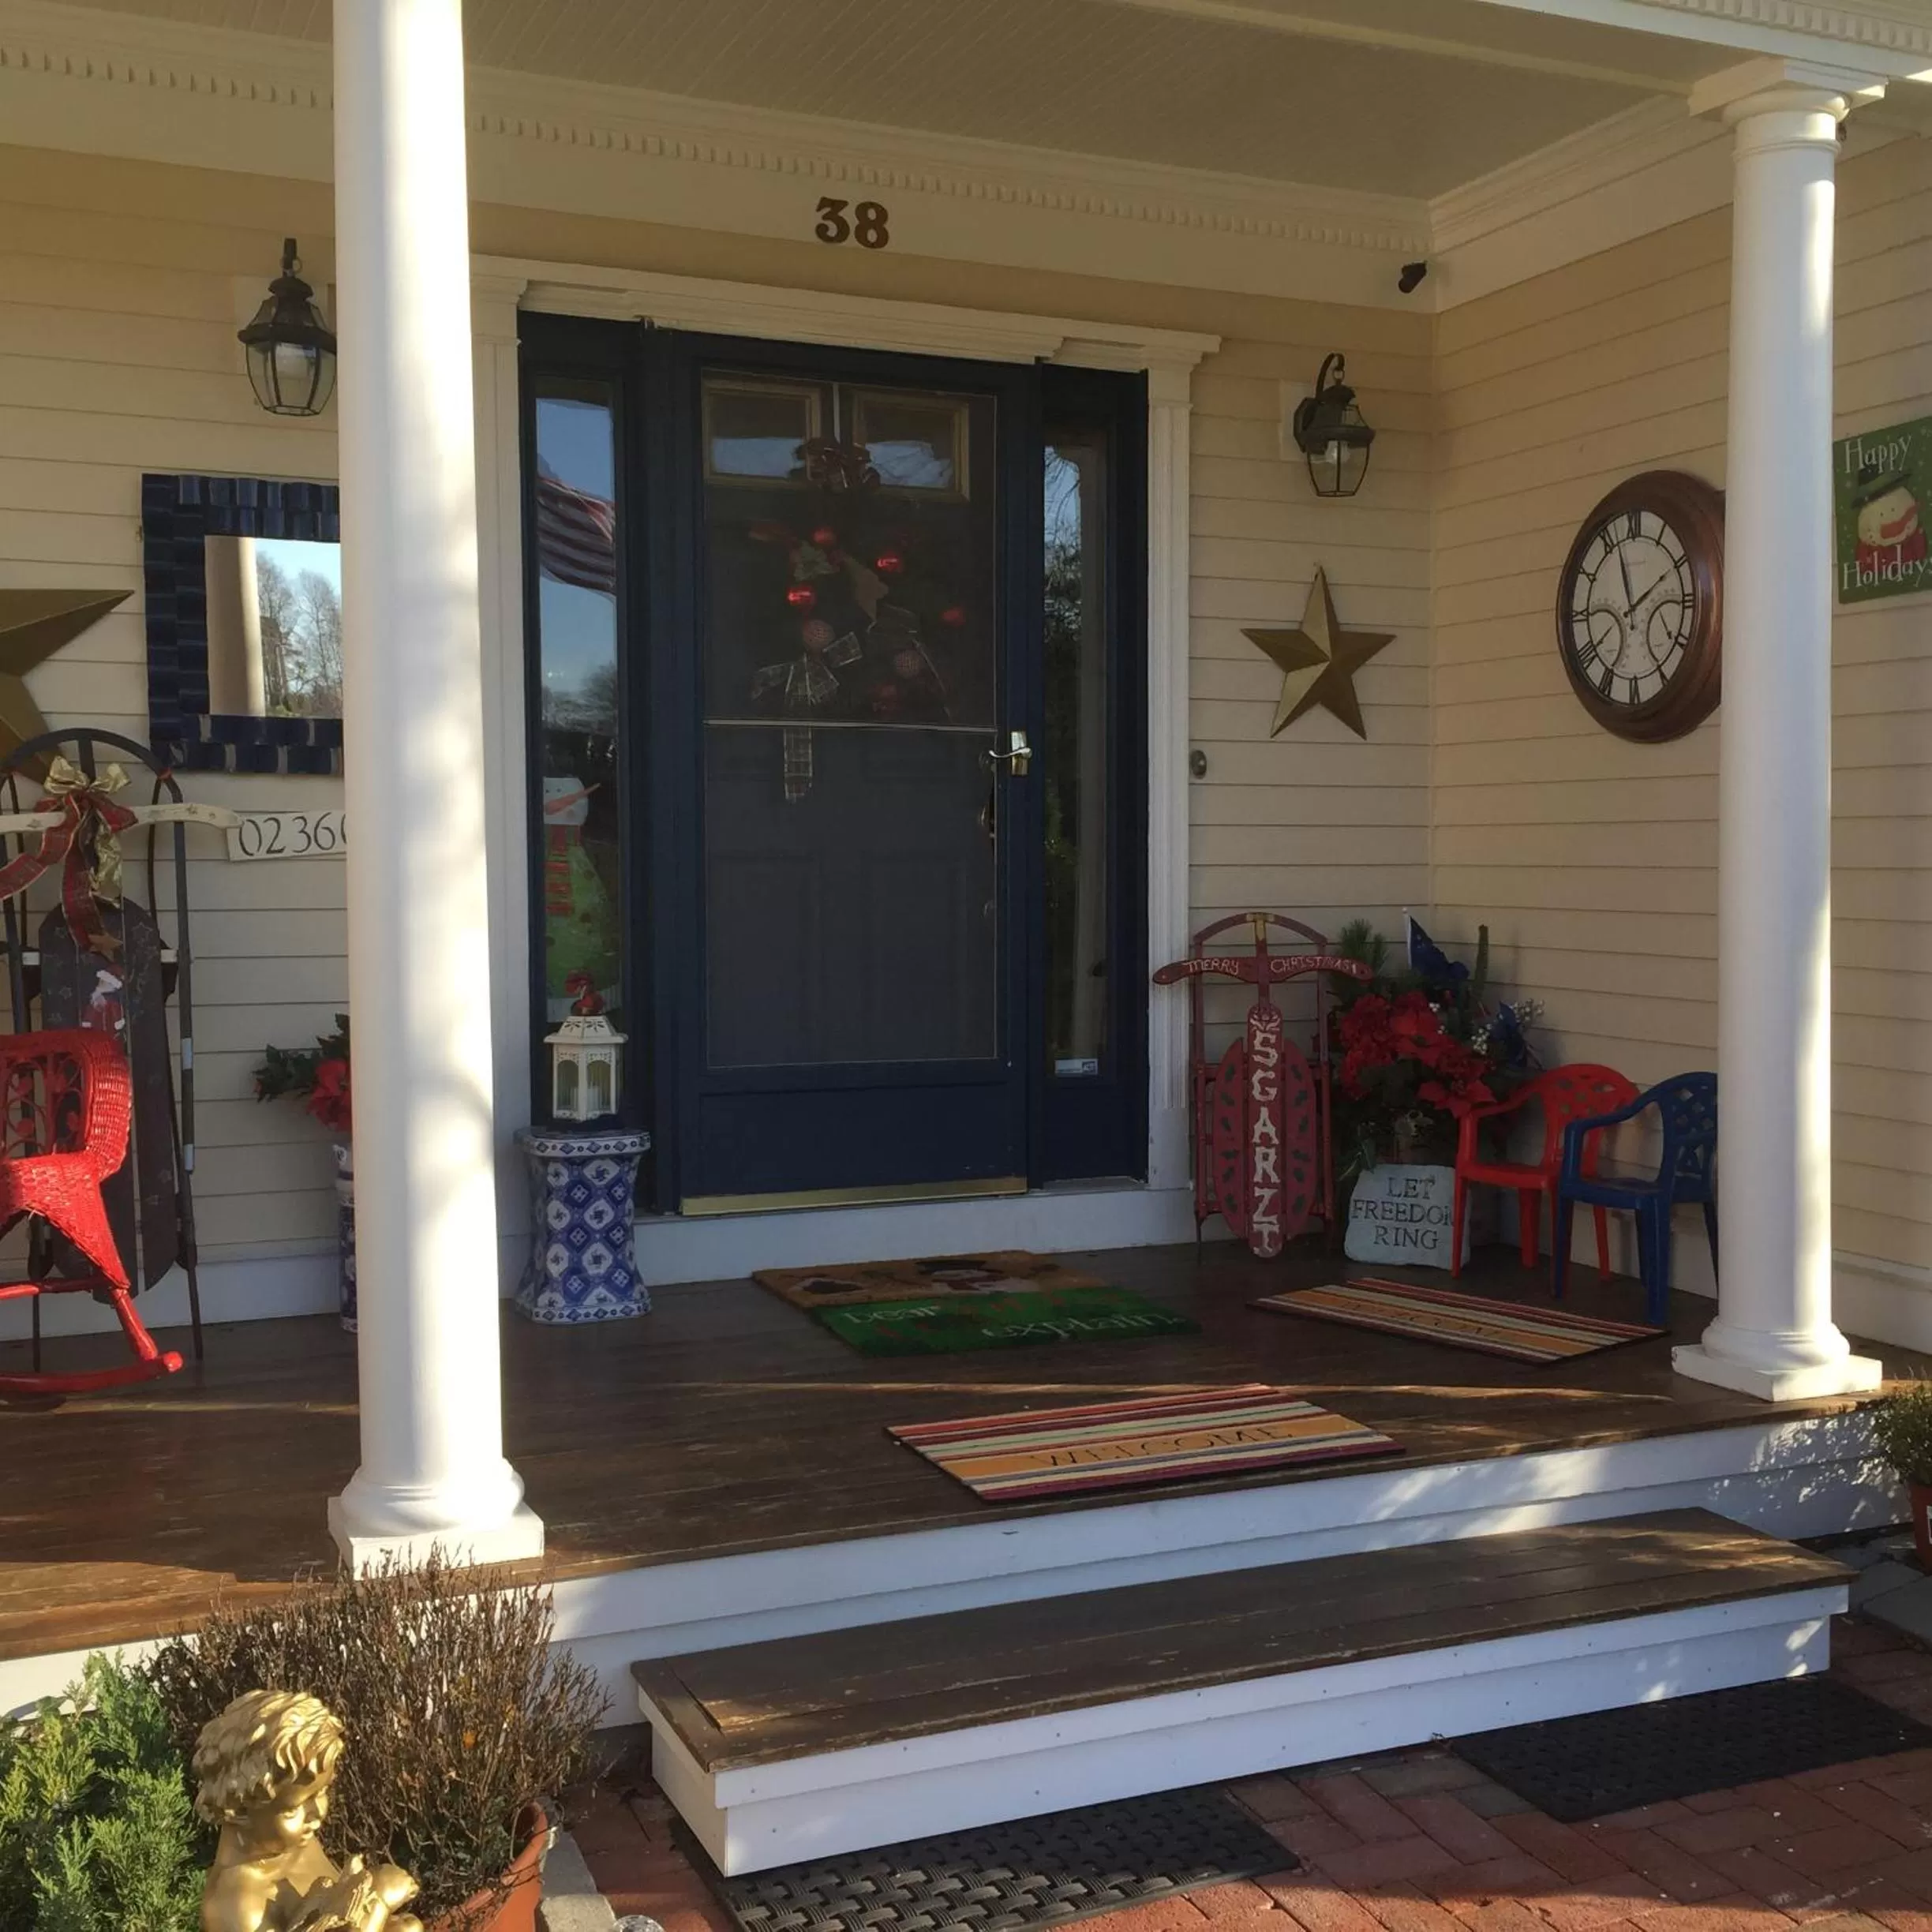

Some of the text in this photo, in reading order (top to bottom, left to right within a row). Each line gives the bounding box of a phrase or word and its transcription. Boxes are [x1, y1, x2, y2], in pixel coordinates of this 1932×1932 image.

[814, 196, 889, 249] 38
[1844, 436, 1911, 473] Happy
[238, 812, 346, 856] 0236
[1182, 957, 1239, 975] MERRY
[1386, 1175, 1436, 1200] LET
[1373, 1225, 1439, 1250] RING
